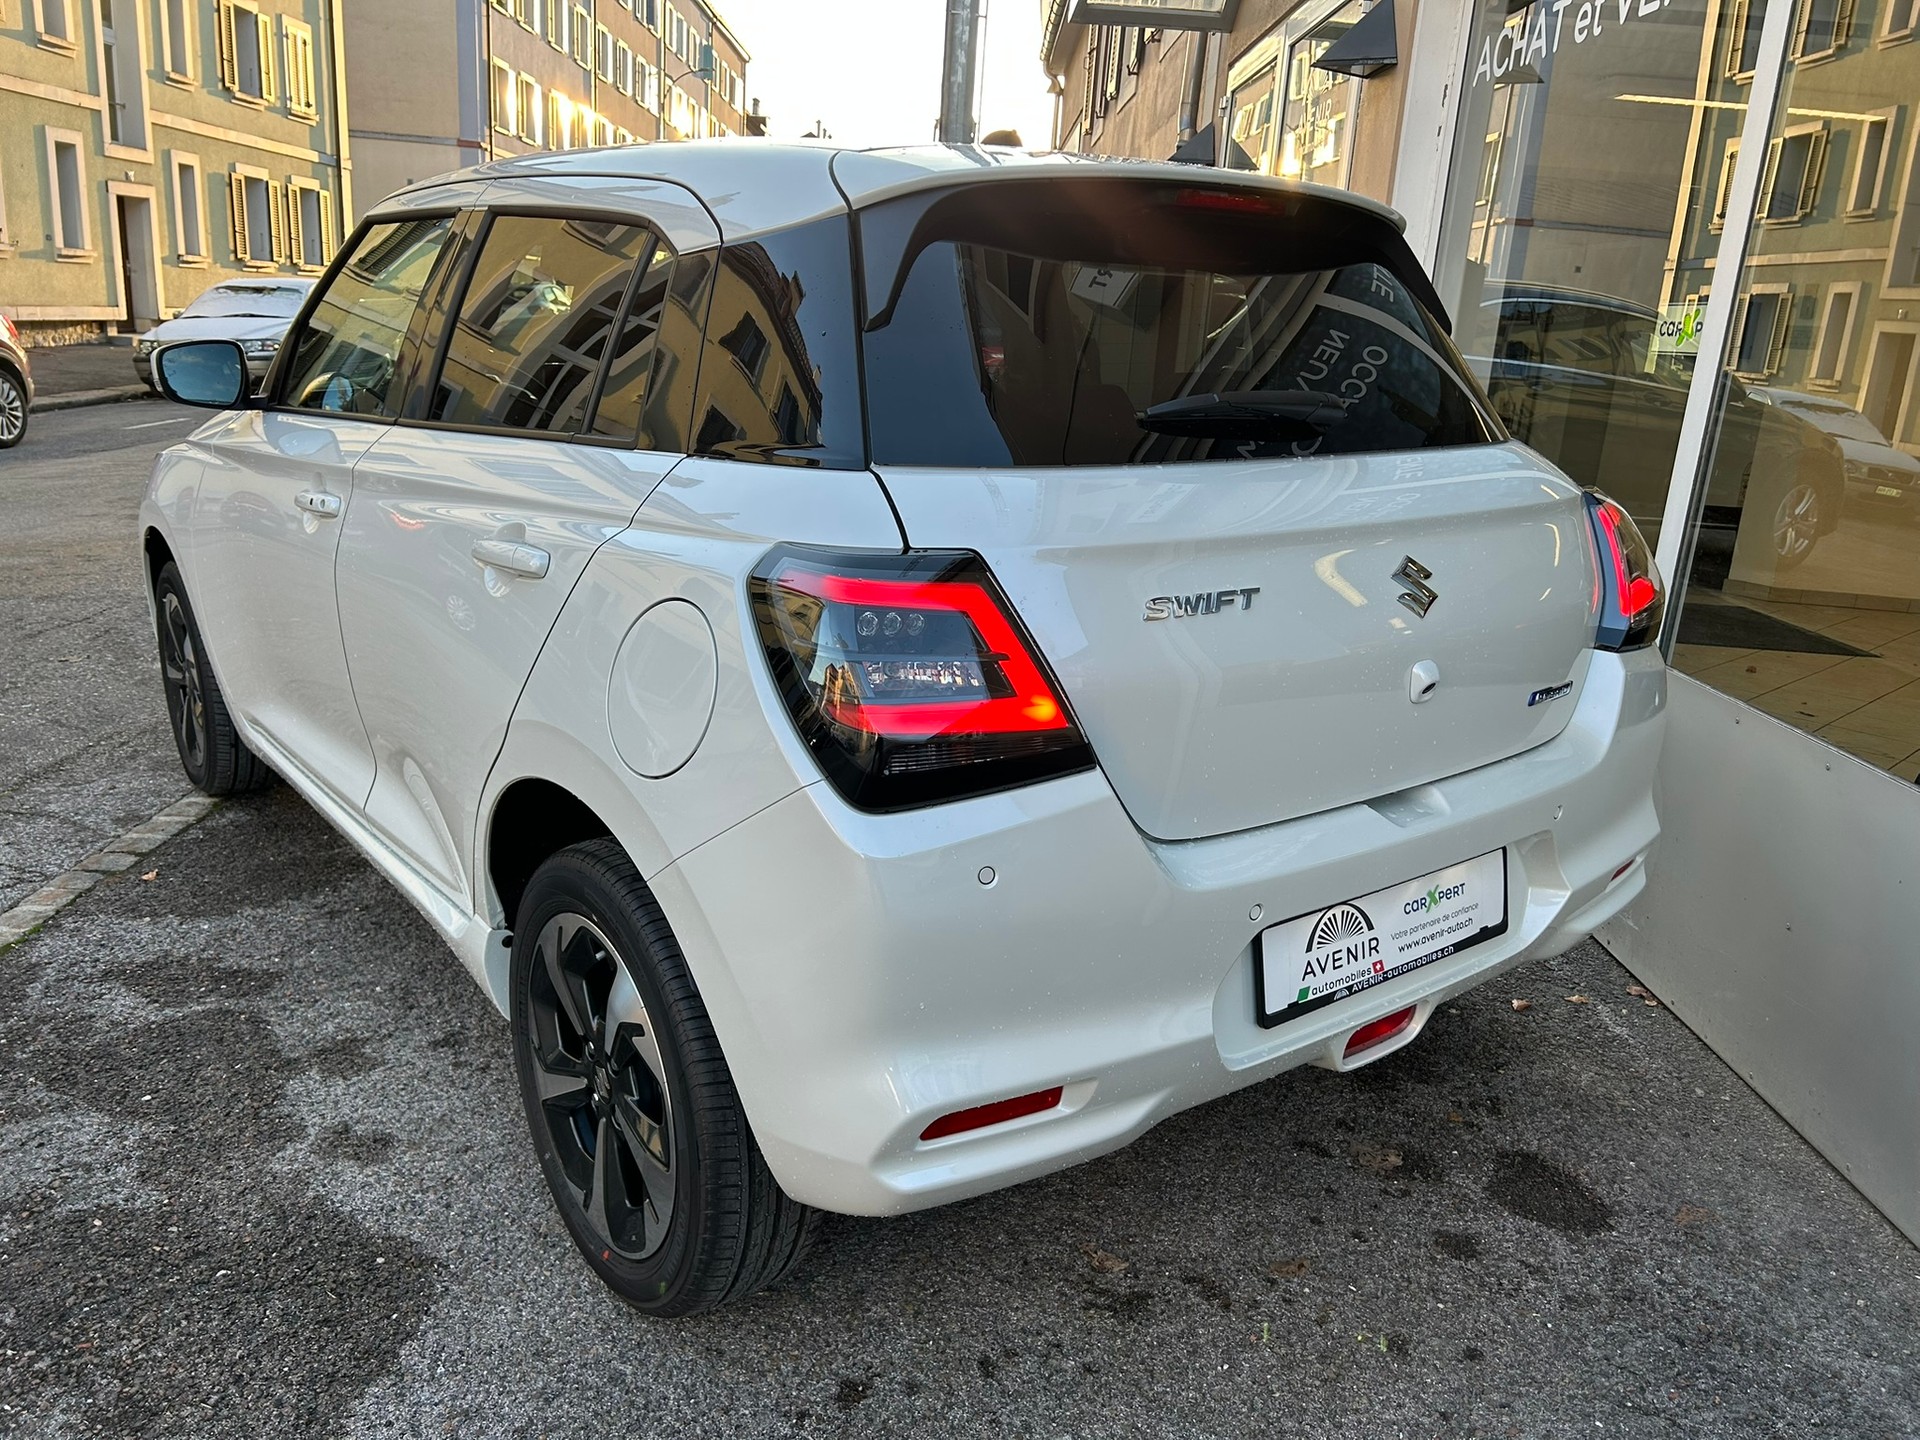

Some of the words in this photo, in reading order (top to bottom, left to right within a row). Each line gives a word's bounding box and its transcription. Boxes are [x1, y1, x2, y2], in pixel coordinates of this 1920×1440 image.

[1472, 0, 1572, 87] ACHAT
[1574, 0, 1605, 43] et
[1143, 587, 1260, 621] SWIFT
[1390, 928, 1409, 941] Votre
[1409, 917, 1441, 936] partenaire
[1441, 913, 1451, 922] de
[1450, 902, 1479, 919] confiance
[1397, 917, 1474, 953] www.avenir-auto.ch
[1302, 936, 1380, 981] AVENIR
[1351, 945, 1454, 993] AVENIR-automobiles.ch
[1311, 966, 1372, 996] automobiles
